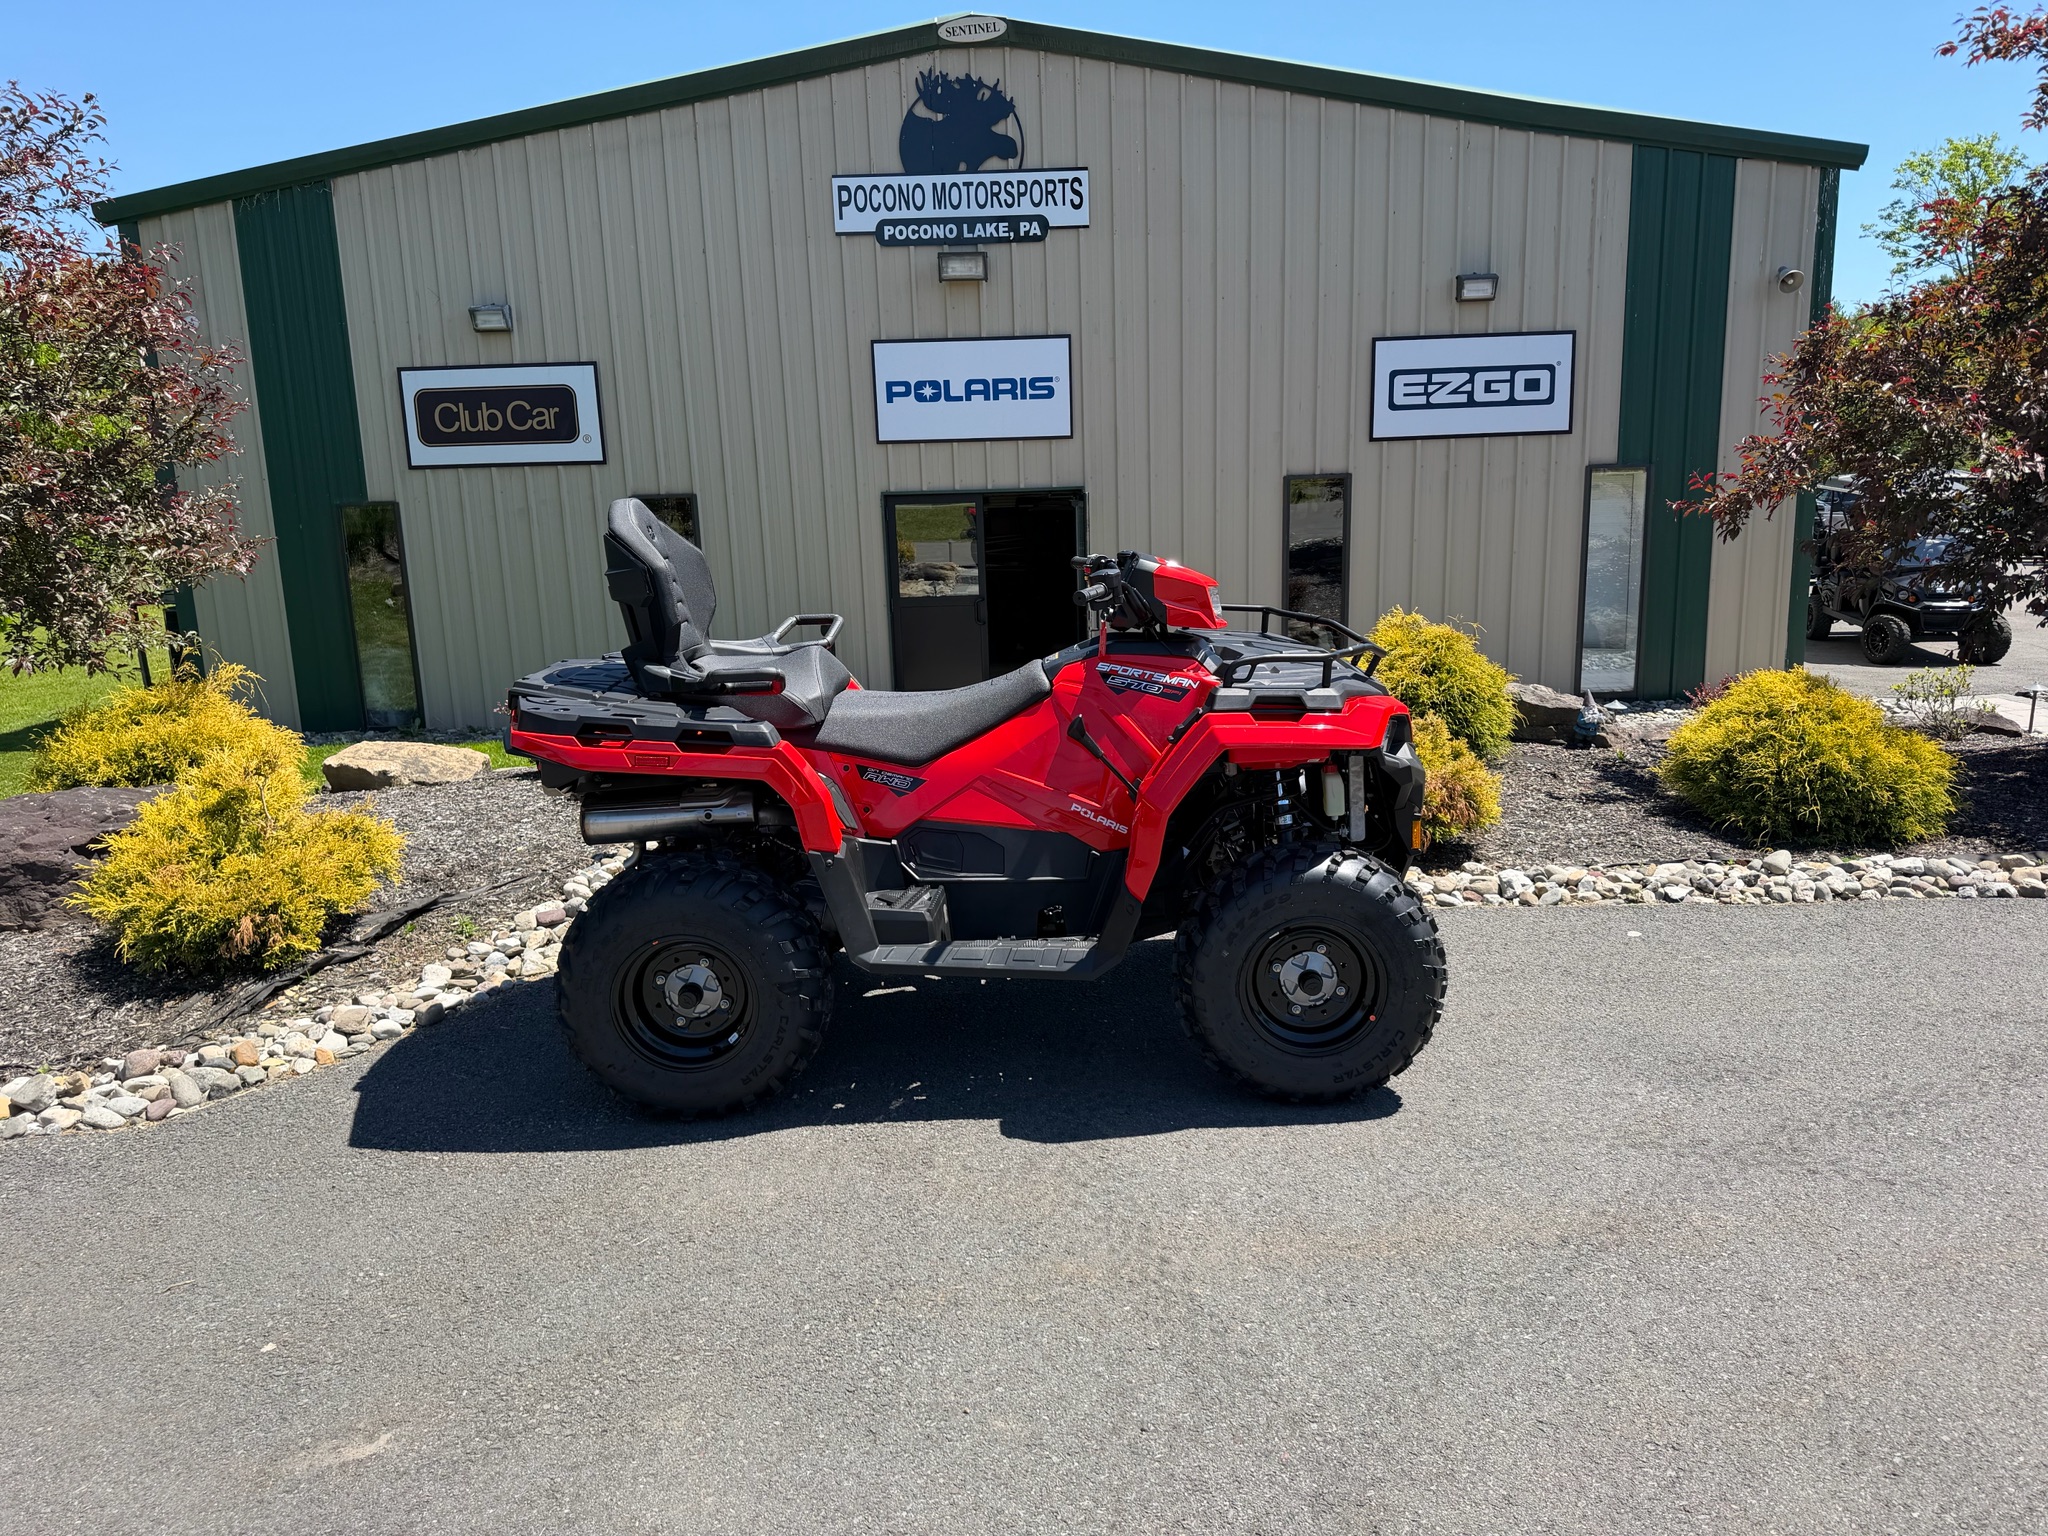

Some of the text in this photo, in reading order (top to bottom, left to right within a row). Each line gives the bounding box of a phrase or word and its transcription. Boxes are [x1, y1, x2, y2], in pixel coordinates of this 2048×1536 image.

[945, 21, 1001, 38] SENTINEL
[837, 177, 1084, 220] POCONO MOTORSPORTS
[884, 221, 1042, 240] POCONO LAKE, PA
[885, 376, 1056, 404] POLARIS
[434, 400, 560, 433] Club Car
[1096, 662, 1200, 689] SPORTSMAN
[1106, 675, 1164, 695] 570
[862, 771, 911, 789] AWD
[1071, 802, 1128, 834] POLARIS
[1332, 1029, 1406, 1085] CARLSTAR
